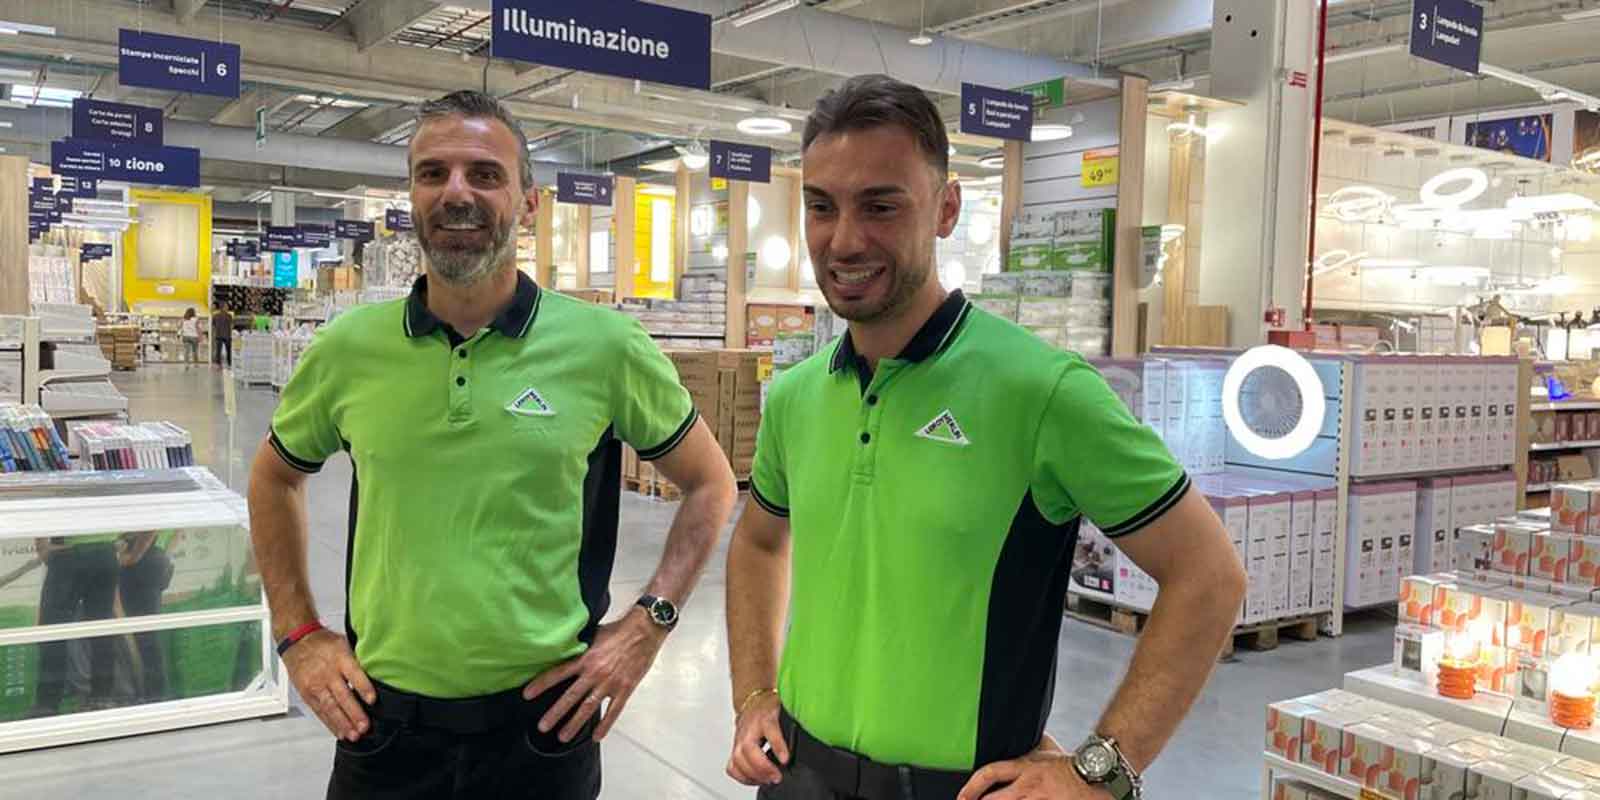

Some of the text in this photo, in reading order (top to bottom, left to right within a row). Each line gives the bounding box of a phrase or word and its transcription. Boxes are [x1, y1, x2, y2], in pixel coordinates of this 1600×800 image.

[1419, 13, 1428, 30] 3
[503, 8, 670, 59] Illuminazione
[120, 47, 152, 59] Stampe
[216, 63, 227, 76] 6
[968, 103, 976, 115] 5
[109, 158, 121, 167] 10
